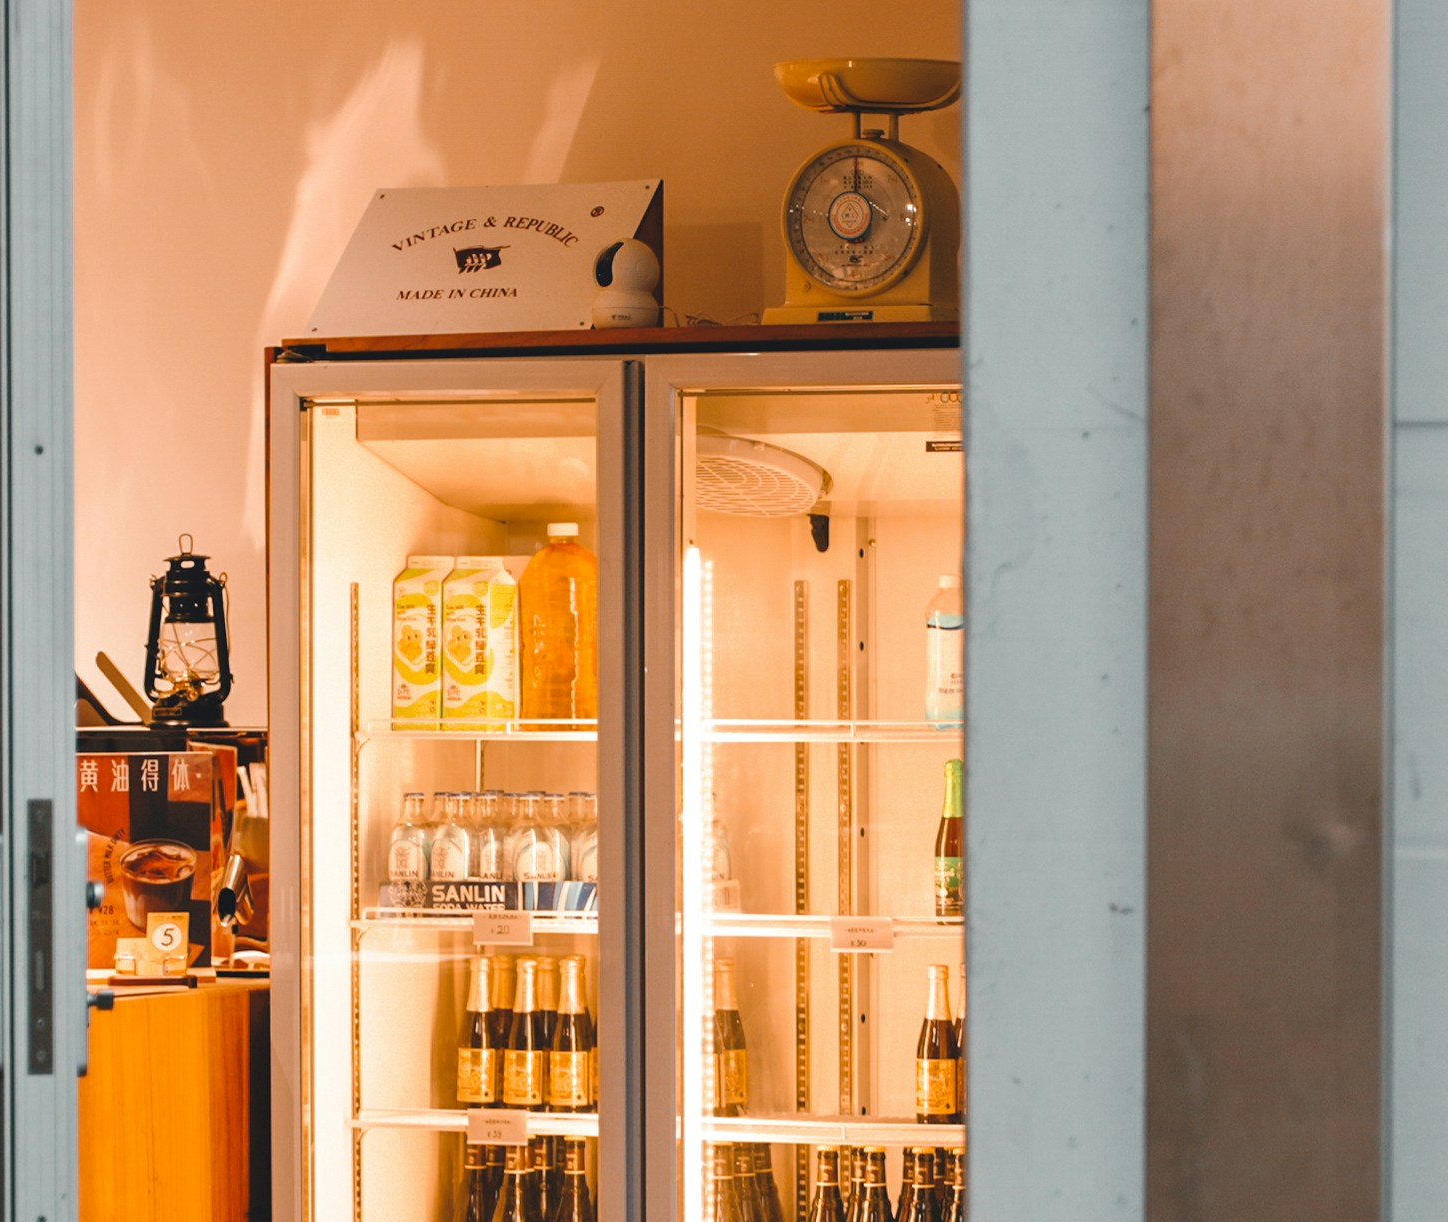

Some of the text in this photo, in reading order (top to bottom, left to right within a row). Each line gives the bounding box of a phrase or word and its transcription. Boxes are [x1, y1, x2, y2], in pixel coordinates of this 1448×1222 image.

[391, 216, 580, 252] VINTAGE & REPUBLIC
[396, 287, 518, 301] MADE IN CHINA
[432, 885, 505, 902] SANLIN
[160, 928, 174, 947] 5
